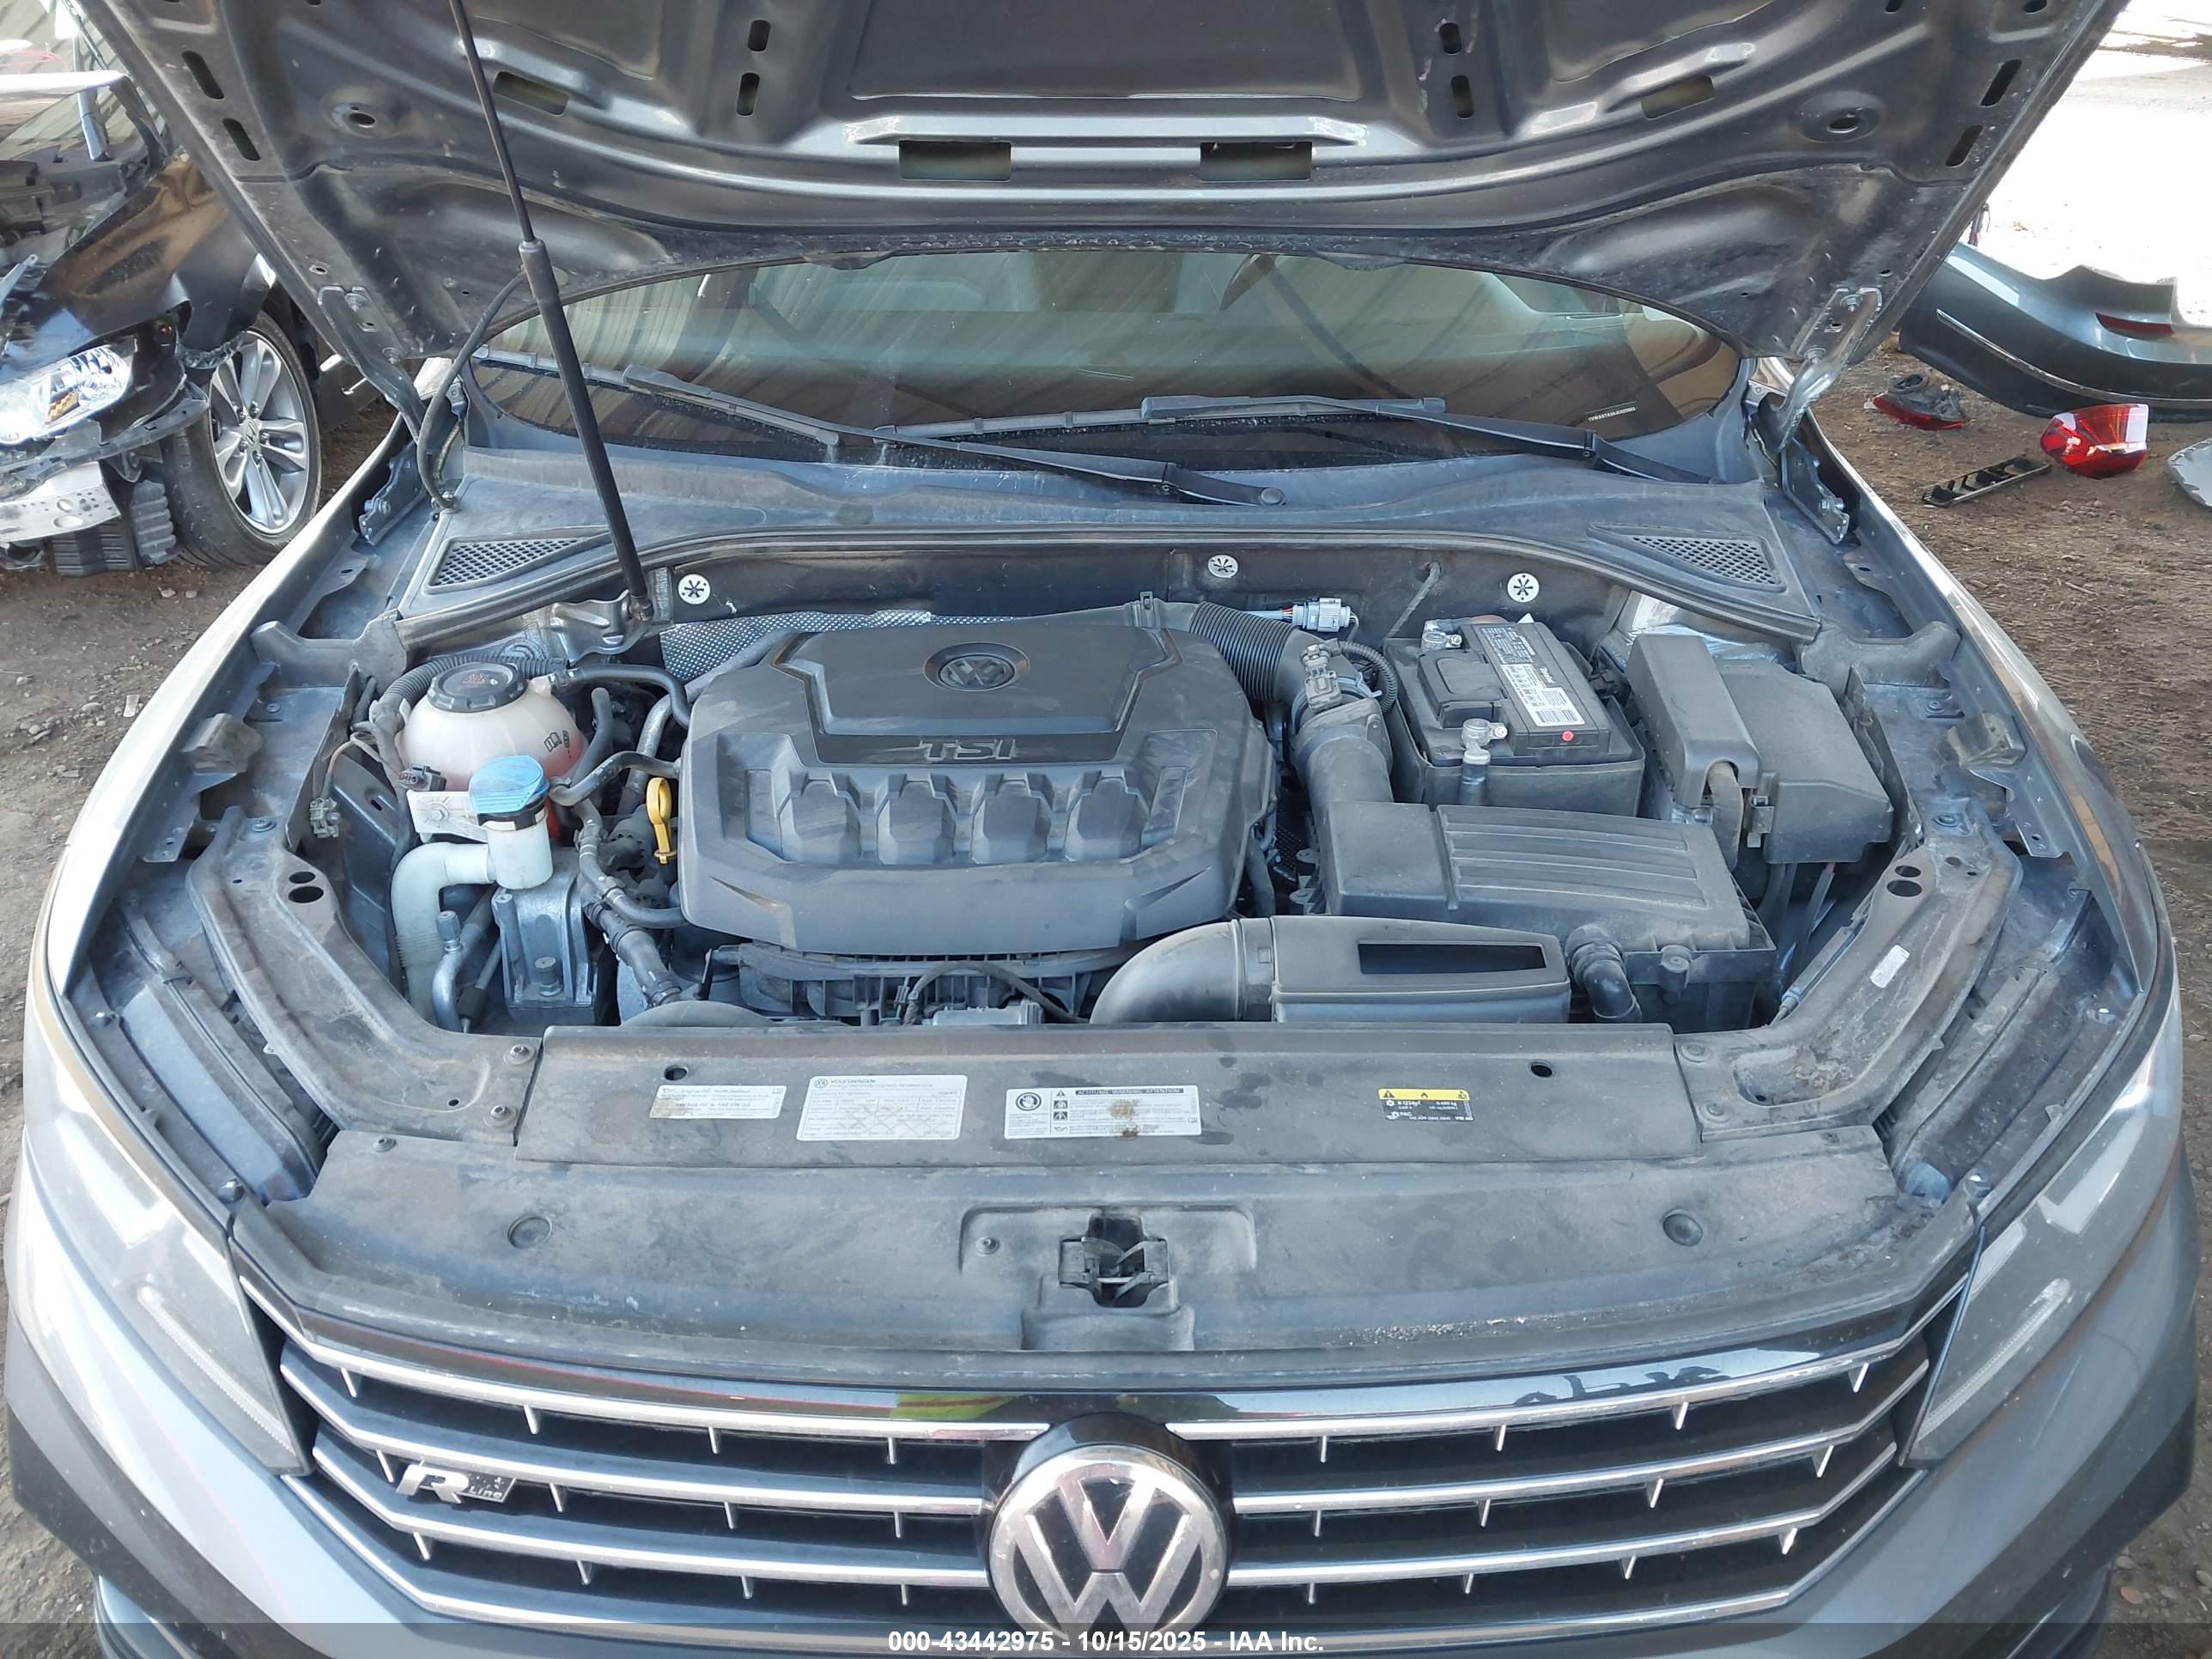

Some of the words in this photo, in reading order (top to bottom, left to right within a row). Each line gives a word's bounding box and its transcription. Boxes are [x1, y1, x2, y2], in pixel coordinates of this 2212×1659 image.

[920, 738, 1017, 761] TSI
[396, 1464, 469, 1504] R
[469, 1485, 502, 1499] Line
